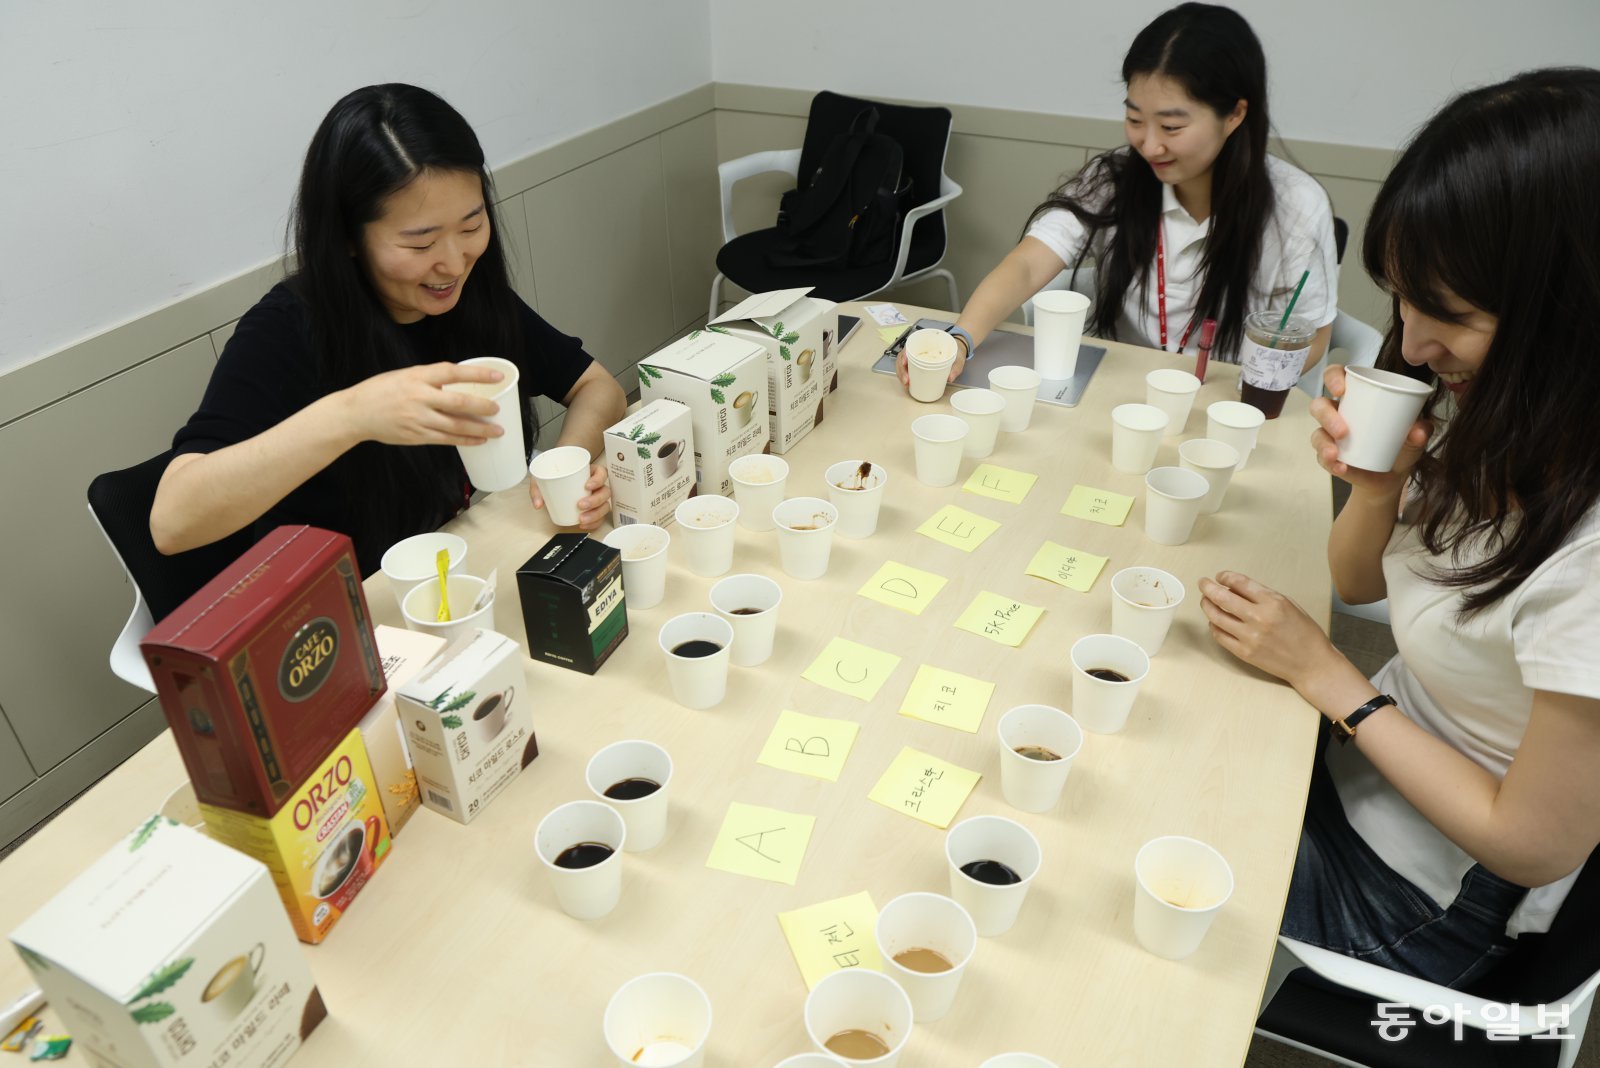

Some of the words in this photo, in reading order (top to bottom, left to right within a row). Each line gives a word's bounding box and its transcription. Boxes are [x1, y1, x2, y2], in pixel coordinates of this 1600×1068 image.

[720, 407, 728, 434] CHYCO
[726, 444, 737, 456] 치코
[737, 434, 752, 449] 마일드
[645, 463, 654, 487] CHYCO
[720, 479, 729, 490] 20
[981, 475, 1011, 493] F
[650, 497, 661, 508] 치코
[661, 486, 676, 501] 마일드
[676, 475, 691, 488] 로스트
[936, 516, 976, 539] E
[880, 577, 918, 599] D
[595, 588, 618, 616] EDIYA
[994, 603, 1021, 621] Price
[295, 631, 321, 661] CAFE
[289, 635, 334, 688] ORZO
[835, 659, 868, 684] C
[457, 731, 470, 761] CHYCO
[468, 768, 483, 785] 치코
[483, 747, 504, 770] 마일드
[506, 727, 525, 752] 로스트
[785, 735, 830, 758] B
[293, 754, 352, 832] ORZO
[468, 799, 479, 813] 20
[735, 827, 786, 863] A
[820, 921, 860, 968] 티젠
[231, 1010, 267, 1050] 마일드
